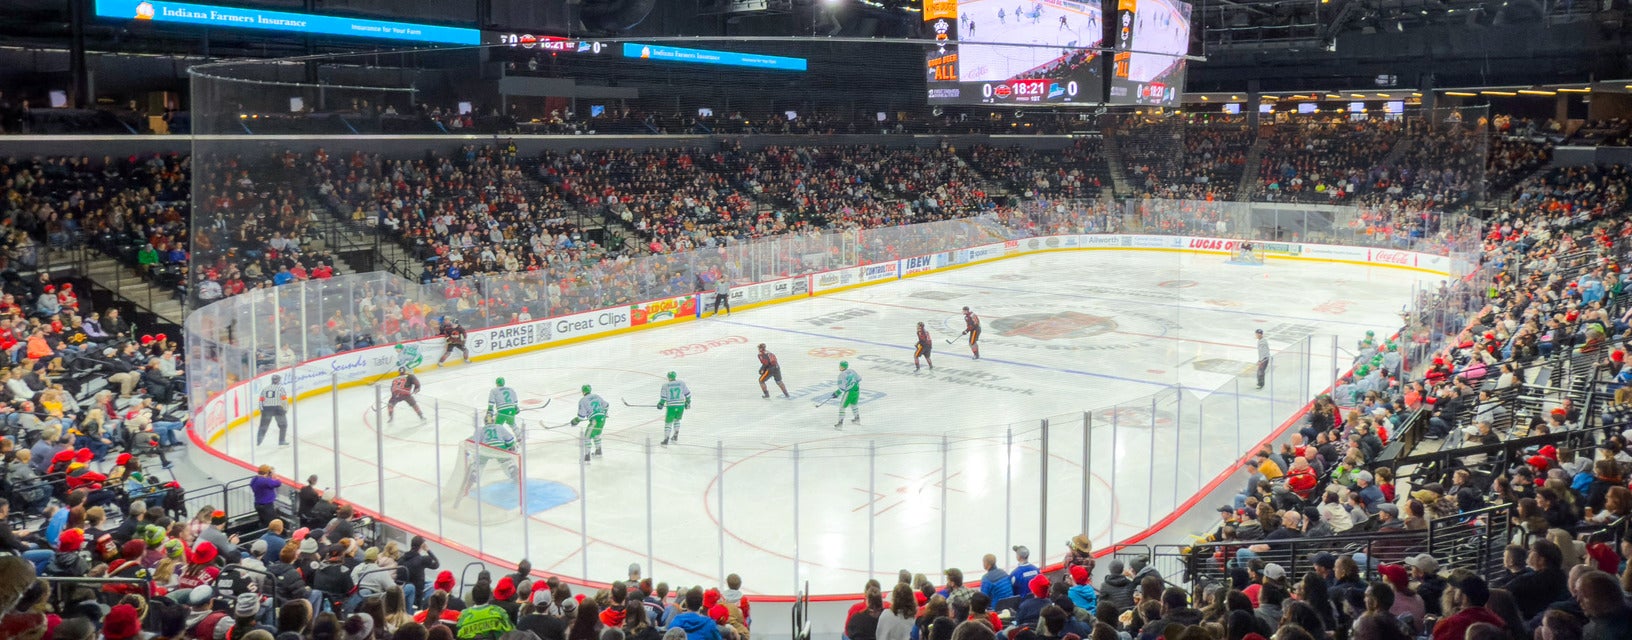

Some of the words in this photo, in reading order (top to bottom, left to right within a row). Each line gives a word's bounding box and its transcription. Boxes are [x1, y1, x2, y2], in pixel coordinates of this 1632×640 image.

[163, 6, 207, 19] Indiana
[210, 11, 254, 23] Farmers
[258, 15, 306, 27] Insurance
[351, 24, 381, 32] Insurance
[593, 41, 601, 53] 0
[653, 49, 674, 57] Indiana
[675, 50, 696, 59] Farmers
[696, 52, 720, 61] Insurance
[935, 64, 958, 80] ALL
[983, 83, 992, 98] 0
[1012, 82, 1045, 95] 18:21
[1067, 80, 1078, 96] 0
[1137, 83, 1143, 99] 0
[1169, 86, 1175, 101] 0
[1189, 239, 1222, 250] LUCAS
[1224, 240, 1242, 251] OIL
[906, 255, 932, 270] IBEW
[1375, 250, 1409, 264] Coca-Cola
[645, 304, 660, 314] RED
[660, 300, 679, 312] GOLD
[556, 318, 594, 333] Great
[598, 313, 627, 328] Clips
[490, 325, 527, 340] PARKS
[491, 336, 527, 350] PLACE
[331, 355, 367, 372] Sounds
